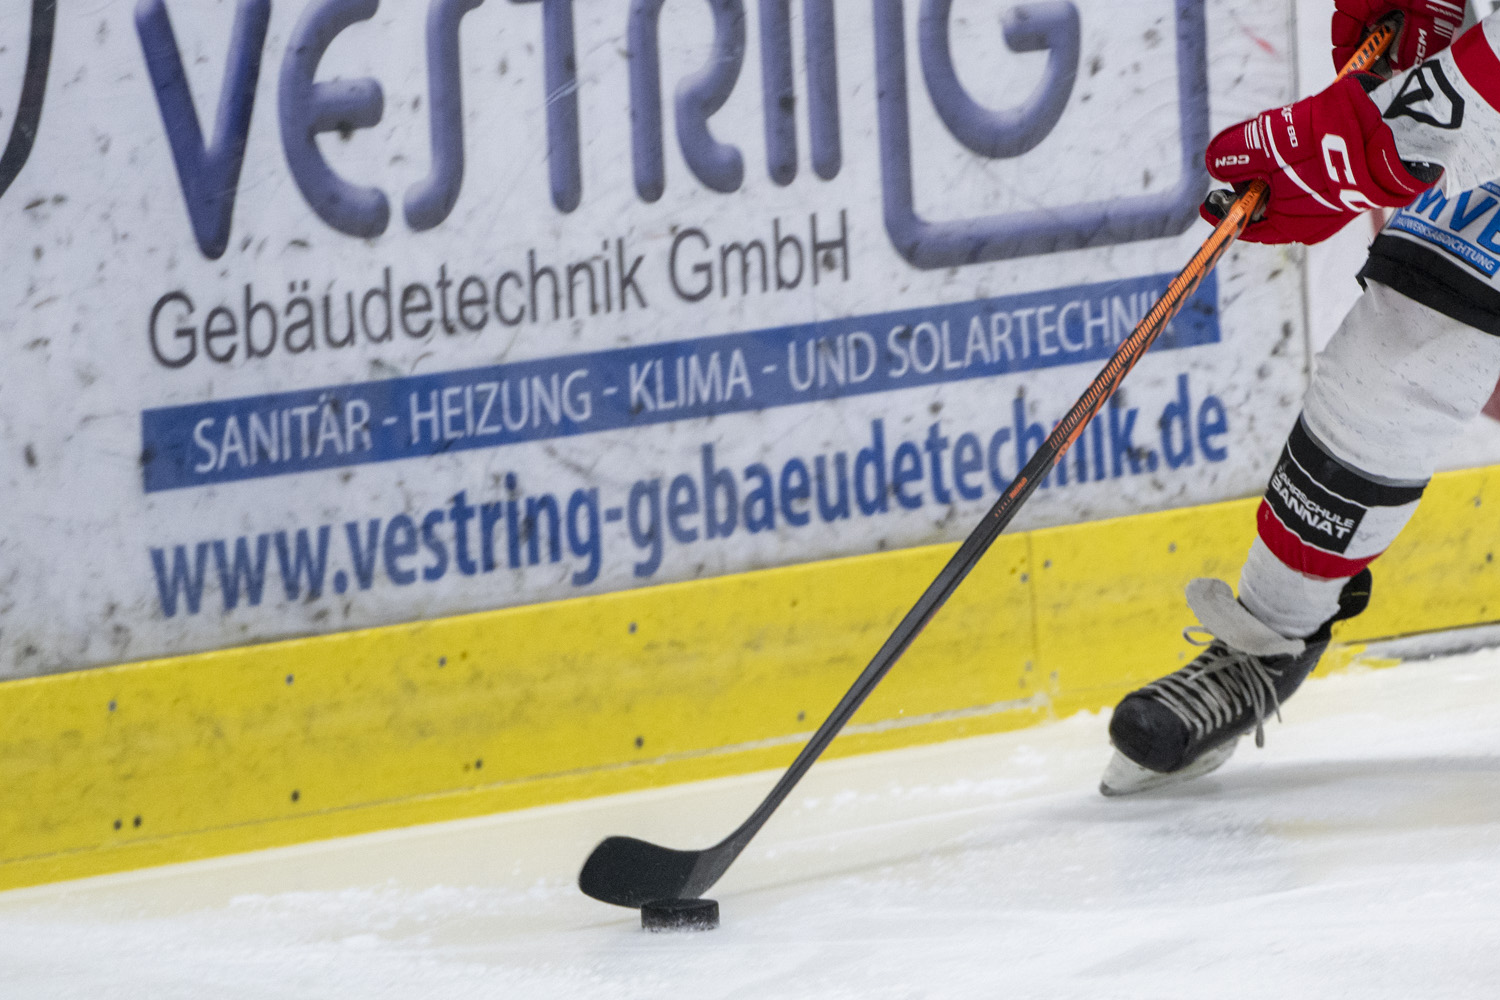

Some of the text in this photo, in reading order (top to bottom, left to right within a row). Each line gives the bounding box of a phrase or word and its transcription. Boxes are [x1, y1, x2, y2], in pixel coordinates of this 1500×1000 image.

[149, 209, 851, 369] Gebäudetechnik GmbH
[193, 394, 372, 473] SANITÄR
[410, 368, 592, 445] HEIZUNG
[628, 348, 752, 414] KLIMA
[788, 330, 877, 393] UND
[887, 288, 1174, 378] SOLARTECHNI
